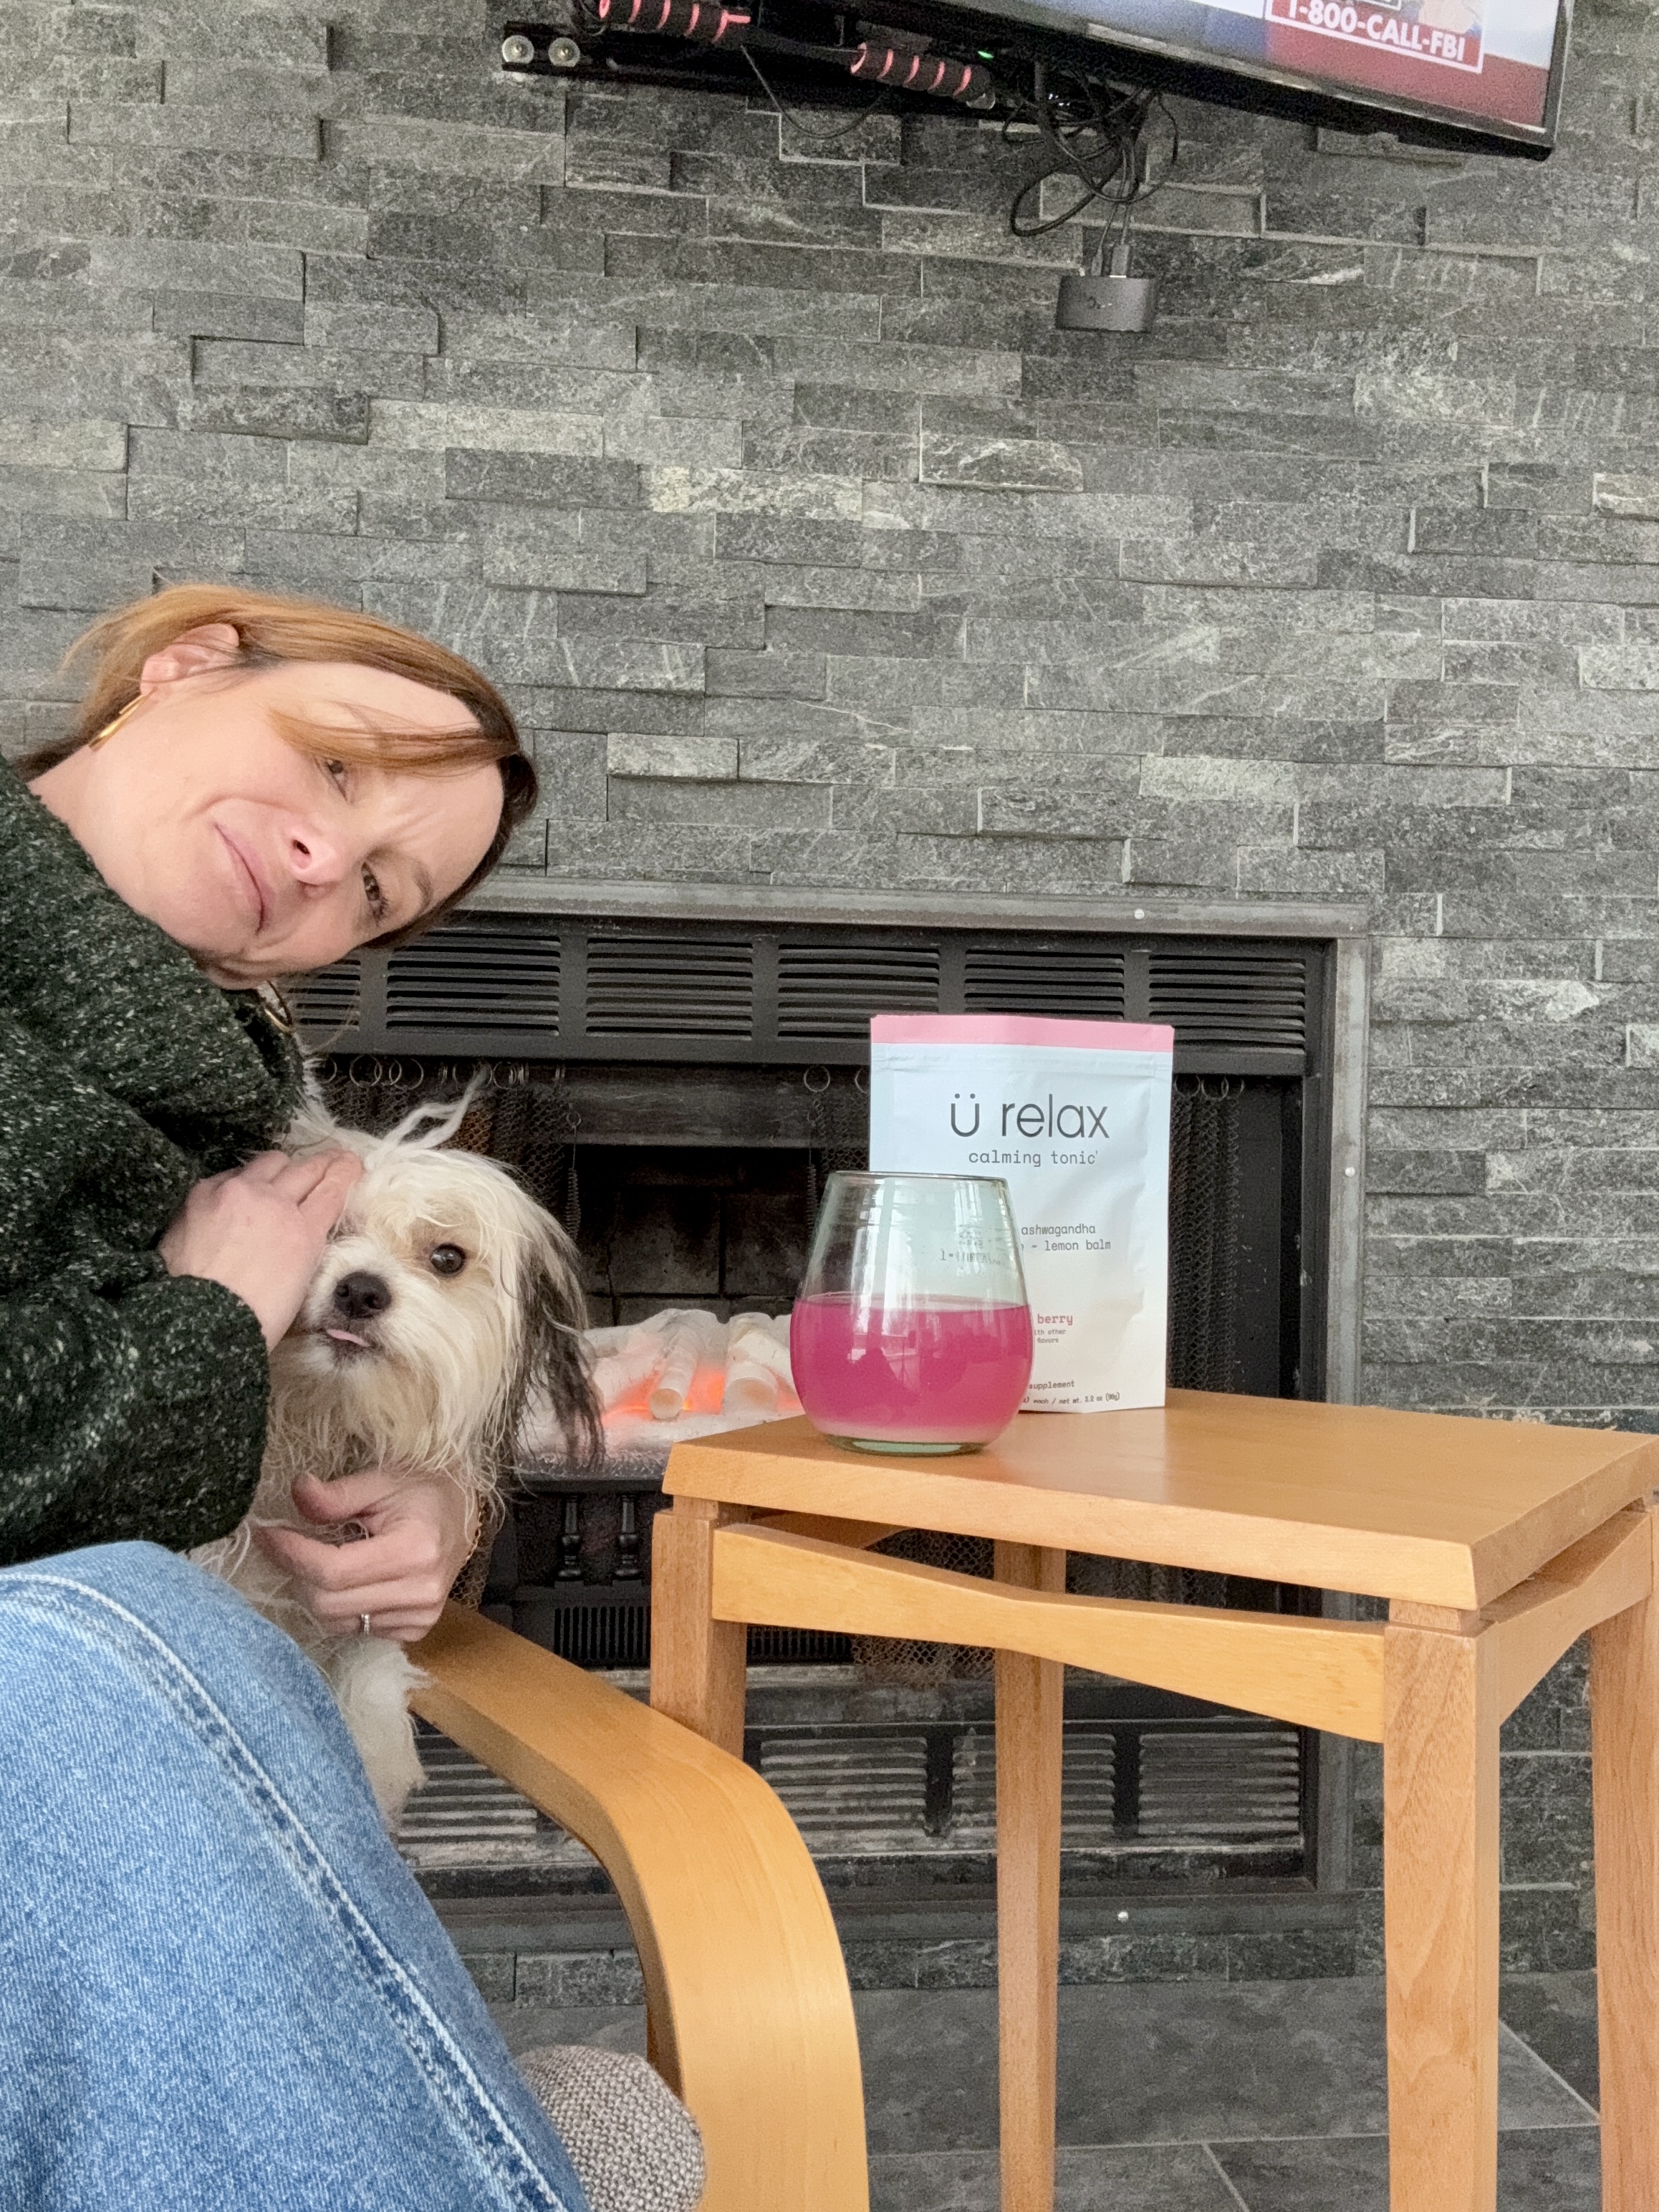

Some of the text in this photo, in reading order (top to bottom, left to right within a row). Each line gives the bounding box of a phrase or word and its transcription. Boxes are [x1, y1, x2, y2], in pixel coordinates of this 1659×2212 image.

[1289, 0, 1466, 62] 1-800-CALL-FBI
[951, 1093, 1110, 1139] Ü relax
[968, 1150, 1042, 1168] calming
[1021, 1223, 1096, 1237] ashwagandha
[1044, 1240, 1079, 1251] lemon
[1086, 1239, 1111, 1251] balm
[1037, 1314, 1074, 1326] berry
[1029, 1379, 1075, 1390] supplement
